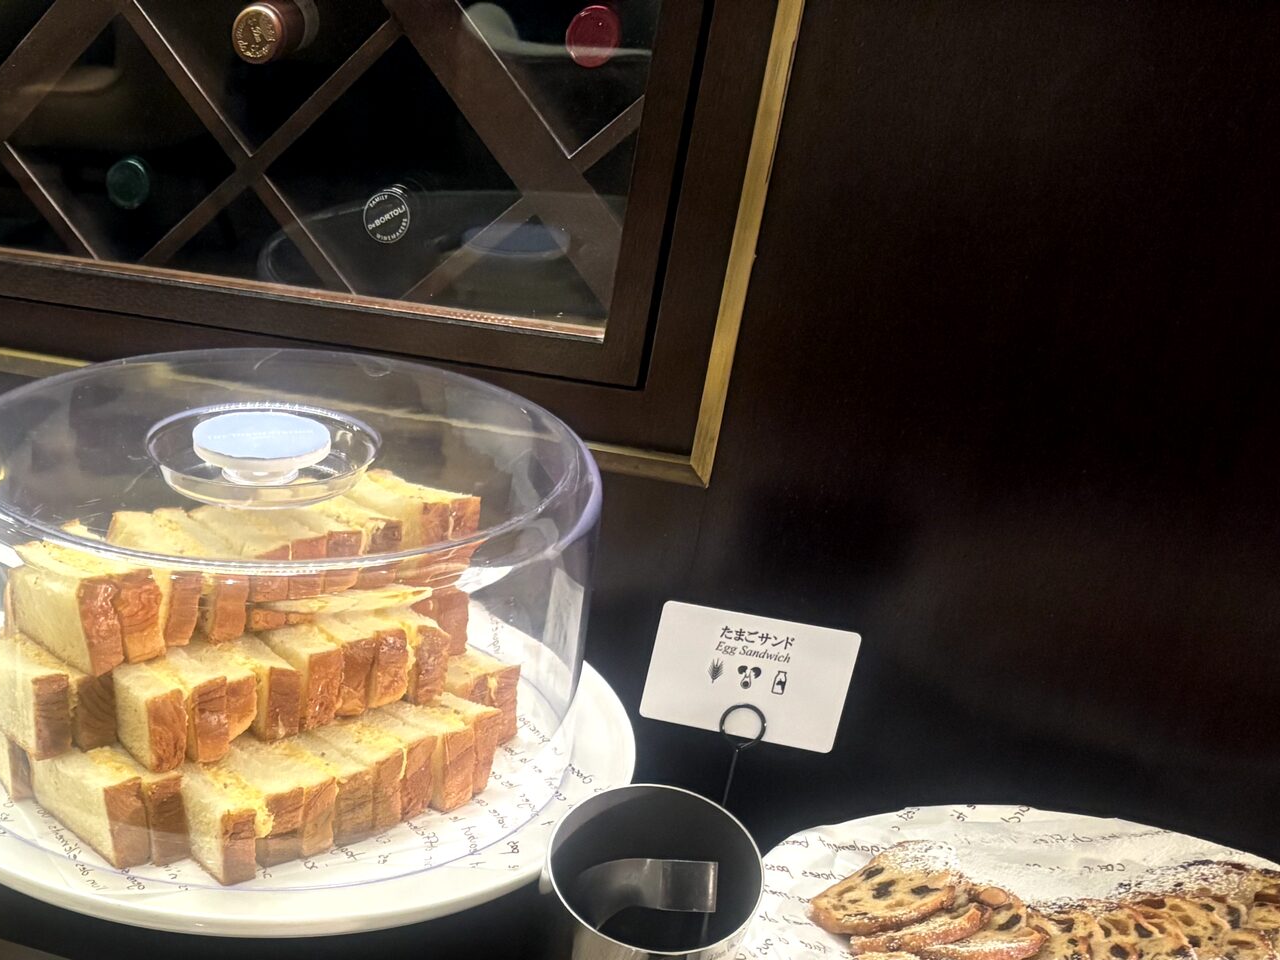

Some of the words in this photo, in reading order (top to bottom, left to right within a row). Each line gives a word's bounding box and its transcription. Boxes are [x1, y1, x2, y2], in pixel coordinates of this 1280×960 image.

[720, 625, 795, 650] たまごサンド
[715, 641, 737, 656] Egg
[738, 645, 791, 664] Sandwich
